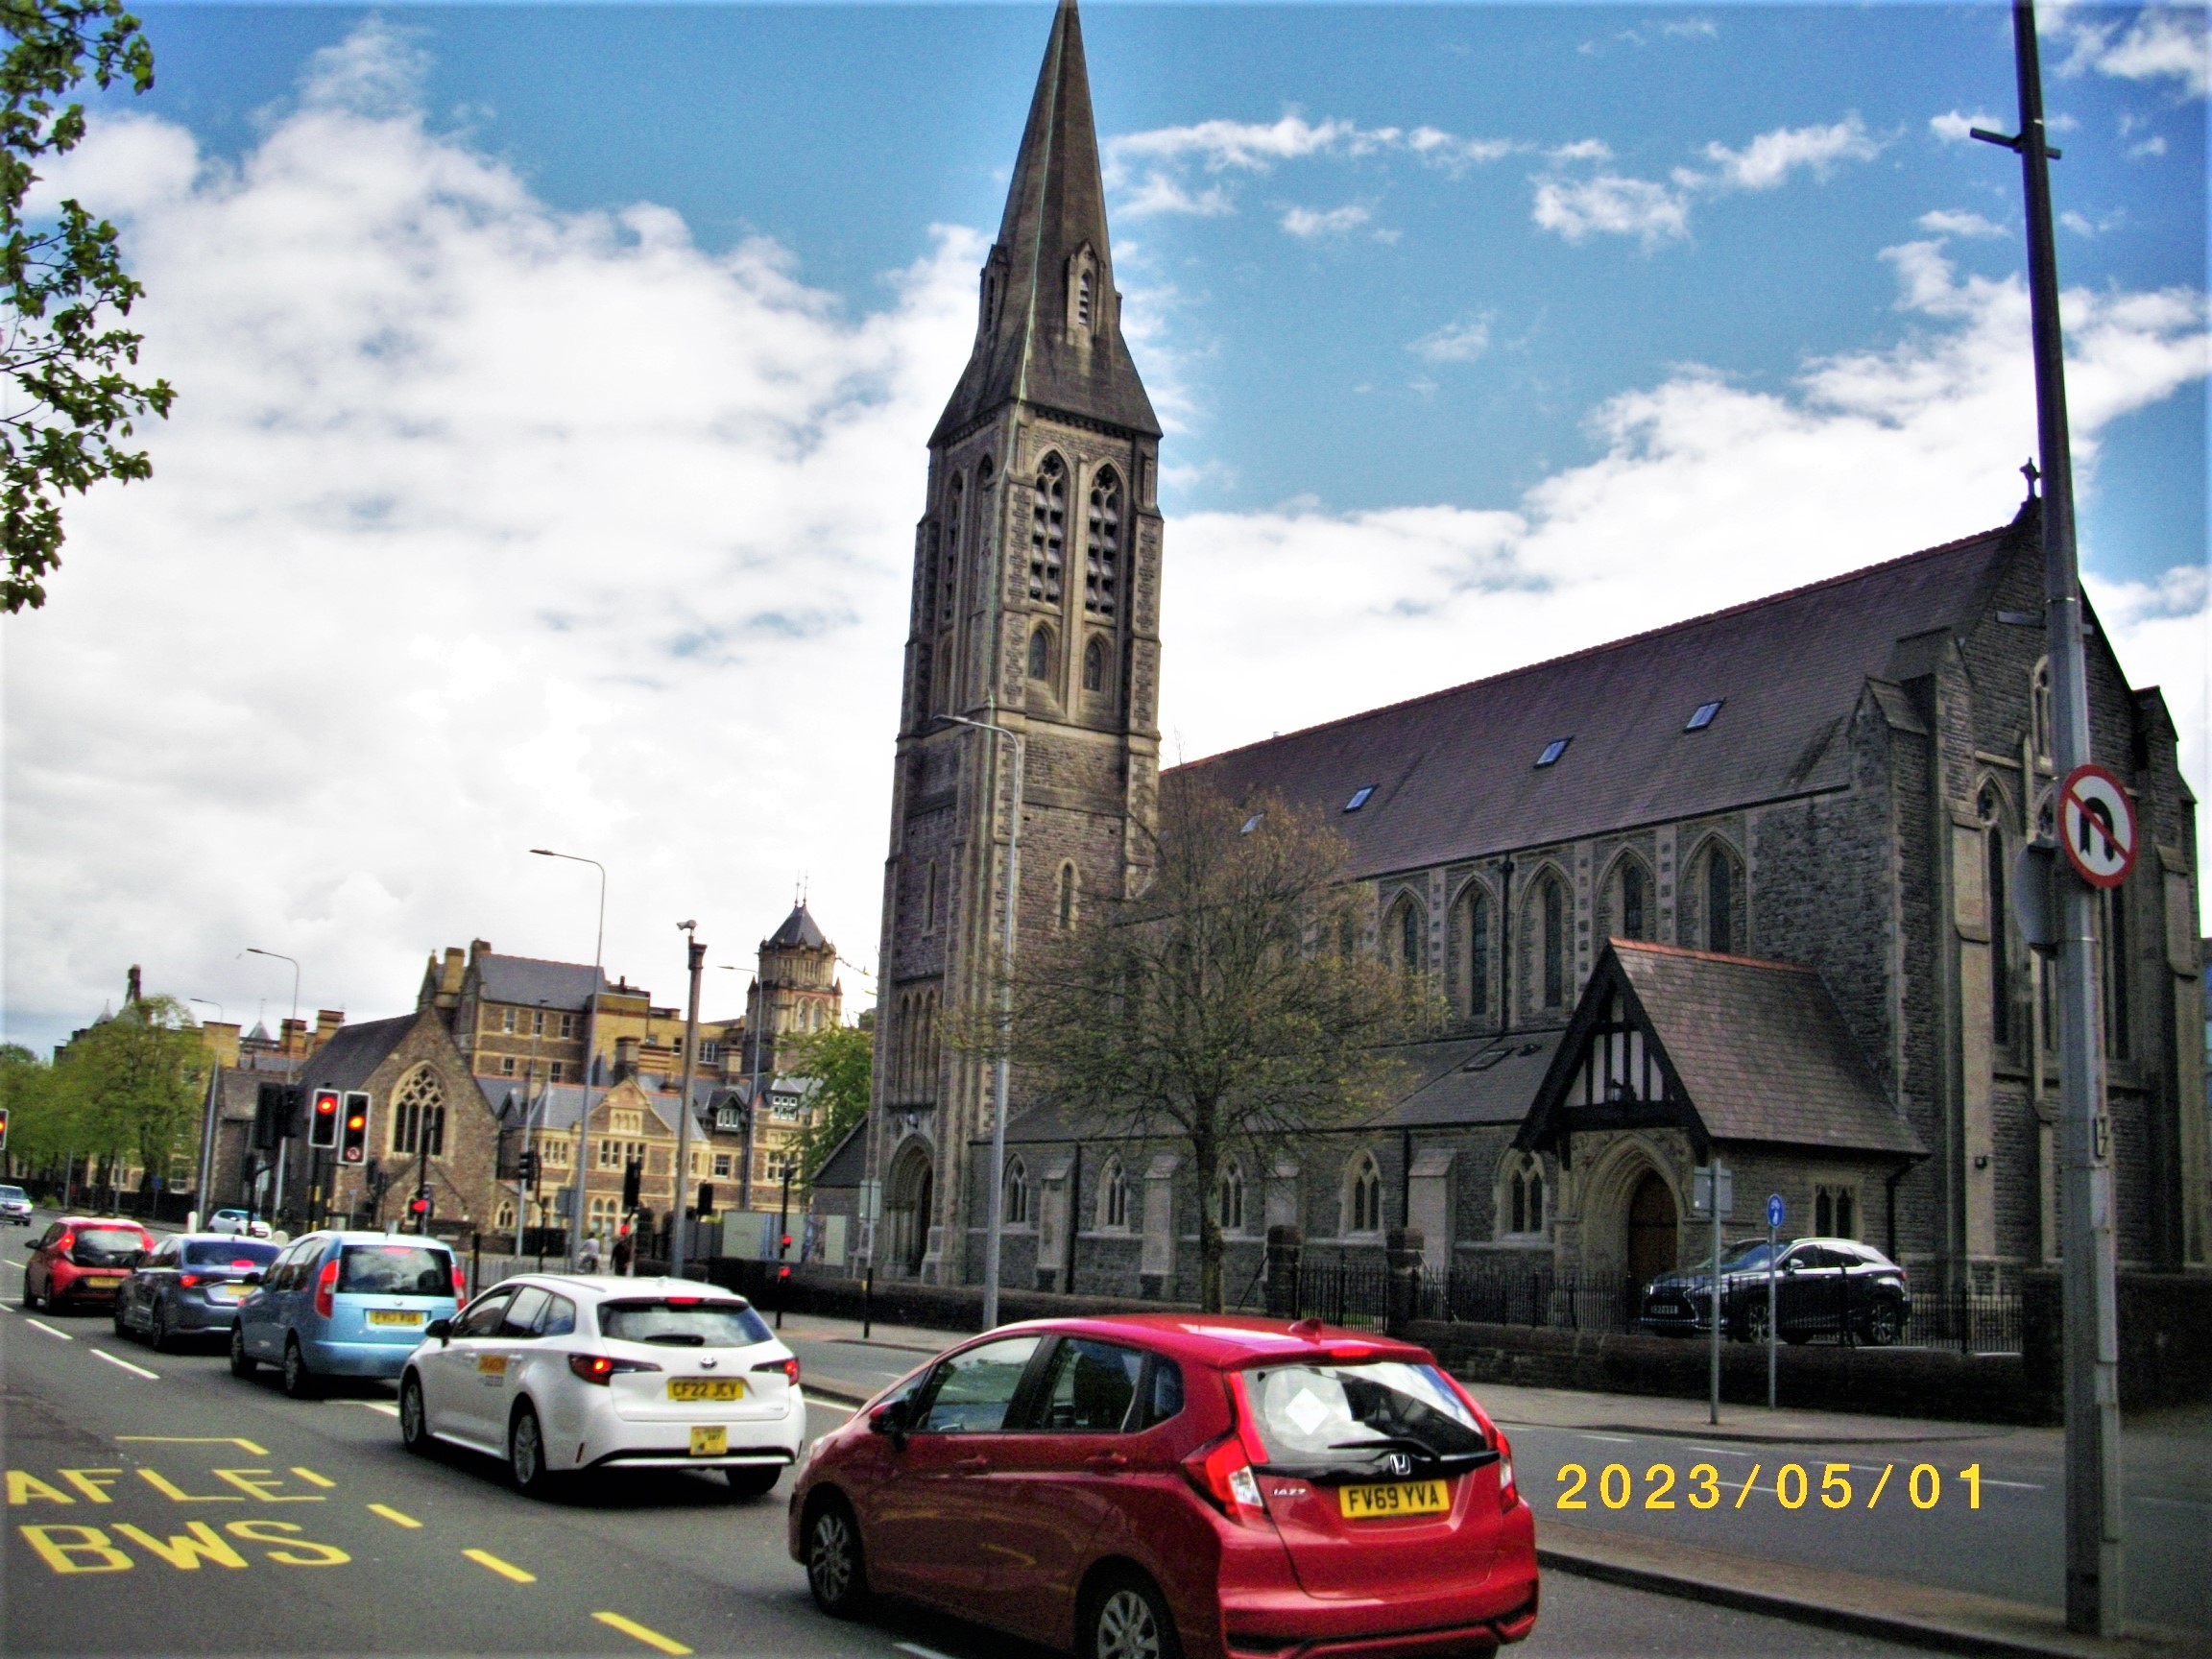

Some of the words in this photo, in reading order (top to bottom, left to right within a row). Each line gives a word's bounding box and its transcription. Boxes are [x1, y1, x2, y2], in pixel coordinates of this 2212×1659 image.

[673, 1382, 708, 1396] CF22
[1348, 1489, 1399, 1511] FV69
[1405, 1484, 1440, 1507] YVA
[19, 1521, 351, 1574] BWS
